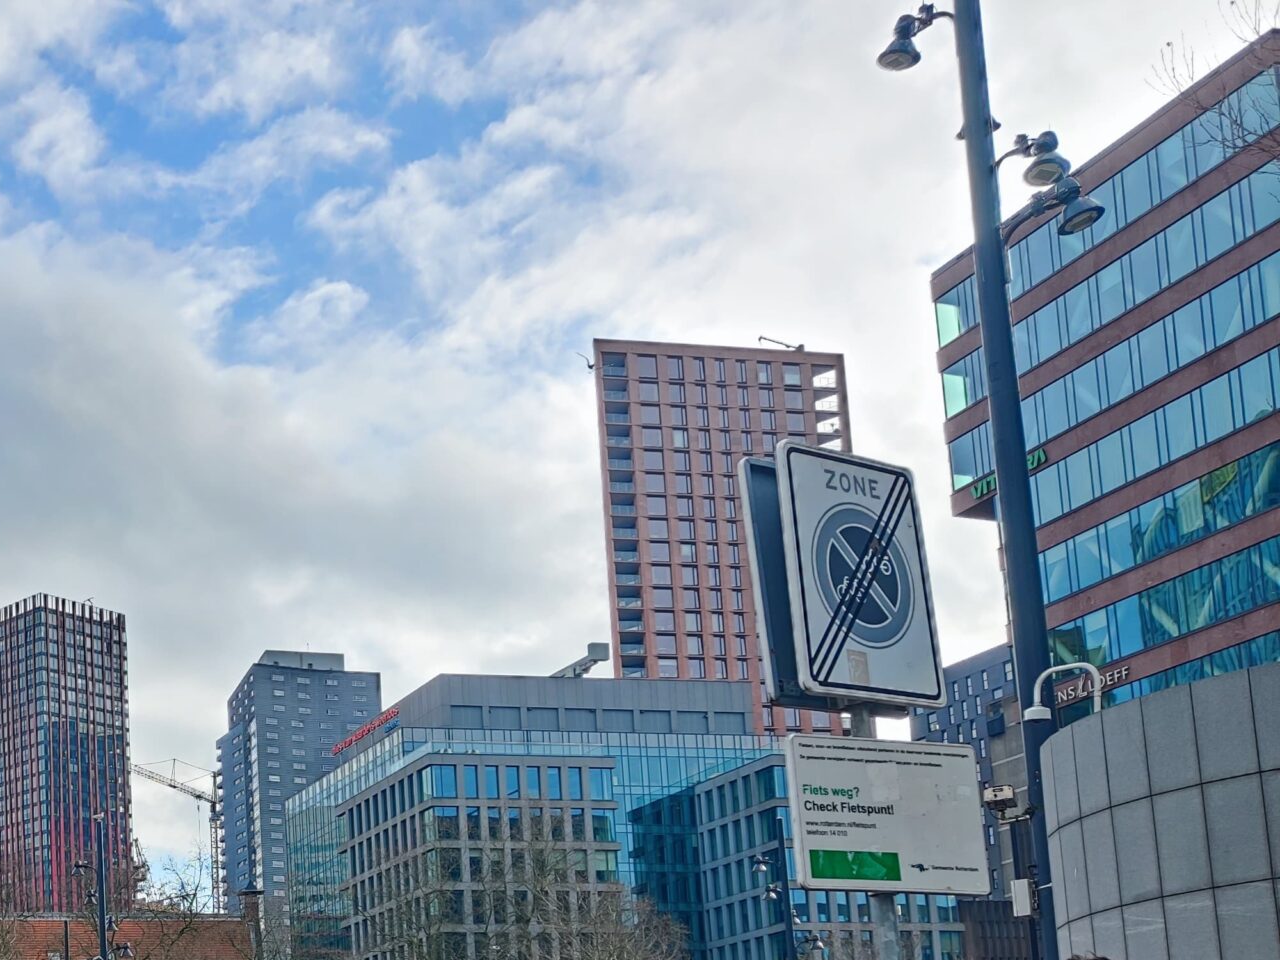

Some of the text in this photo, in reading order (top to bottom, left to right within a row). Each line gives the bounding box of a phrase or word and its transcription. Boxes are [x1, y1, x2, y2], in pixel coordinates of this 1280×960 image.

[823, 469, 881, 500] ZONE
[802, 784, 859, 799] Fiets weg?
[804, 800, 894, 816] Check Fietspunt!
